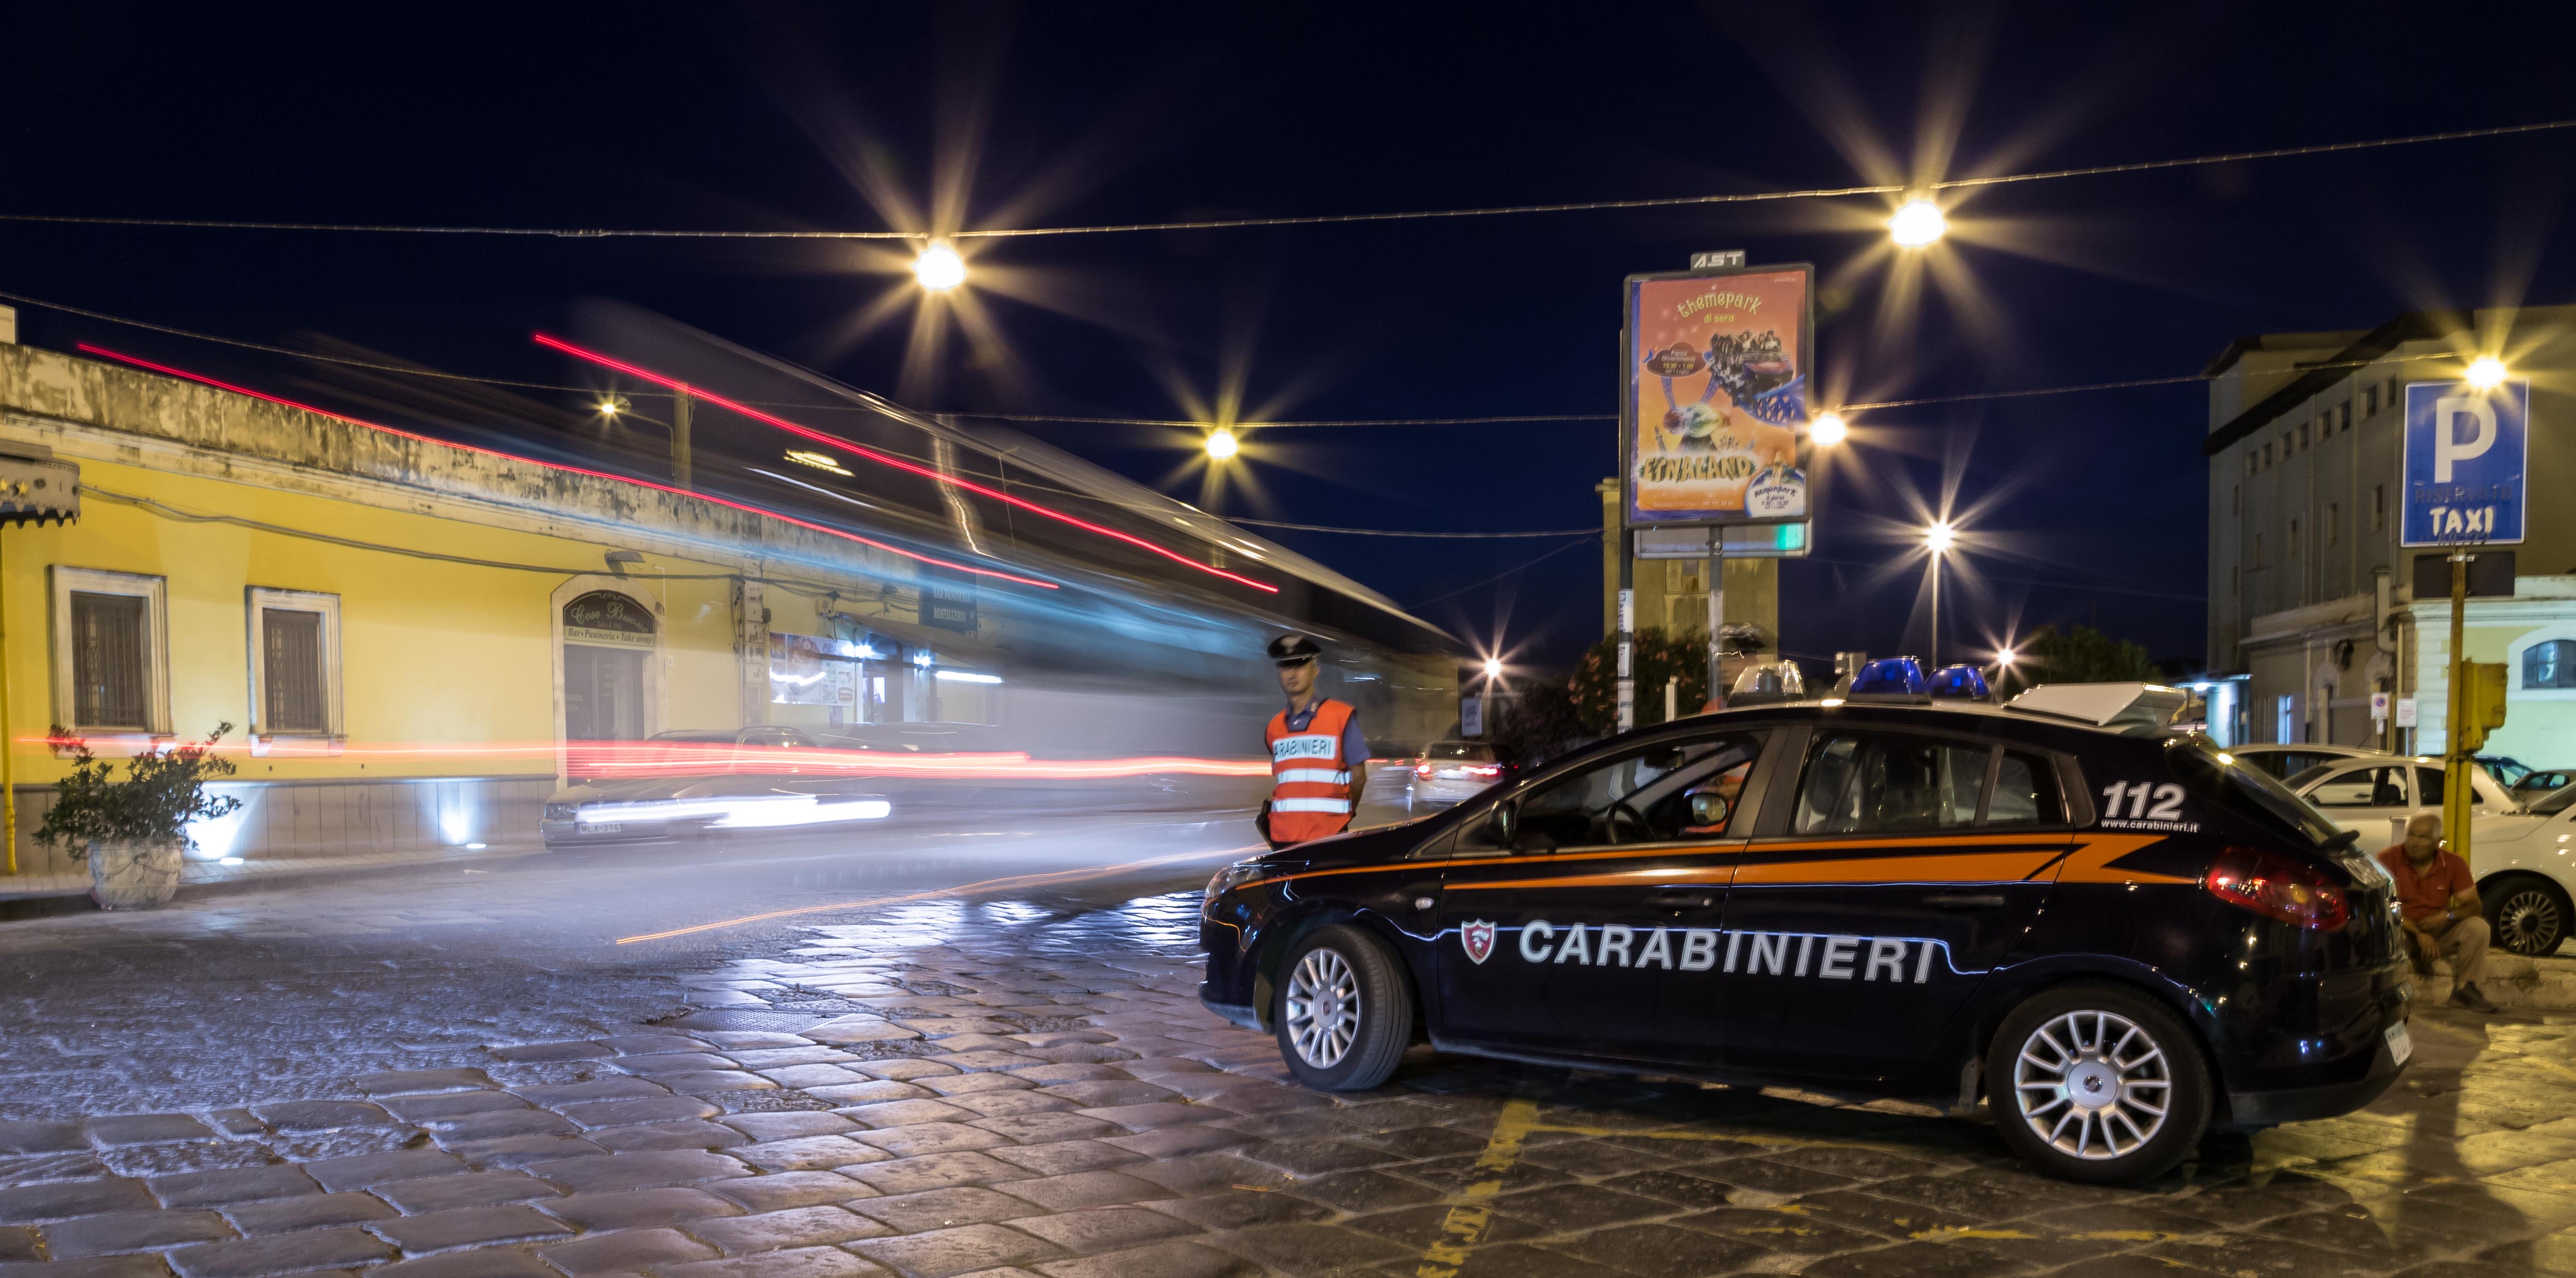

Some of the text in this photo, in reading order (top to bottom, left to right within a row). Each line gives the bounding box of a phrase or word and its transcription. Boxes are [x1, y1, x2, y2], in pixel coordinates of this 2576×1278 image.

[1693, 251, 1743, 268] AST
[1677, 291, 1762, 318] themepark
[1704, 314, 1734, 323] di sera
[2434, 397, 2497, 484] P
[1643, 455, 1752, 483] ETNALAND
[2429, 506, 2494, 536] TAXI
[571, 605, 600, 625] Cose
[934, 607, 966, 622] ROSTICCERIA
[568, 627, 653, 645] Bar Panineria Take away
[2103, 780, 2186, 821] 112
[2101, 820, 2198, 833] www.carabinieri.it
[1519, 919, 1936, 984] CARABINIERI
